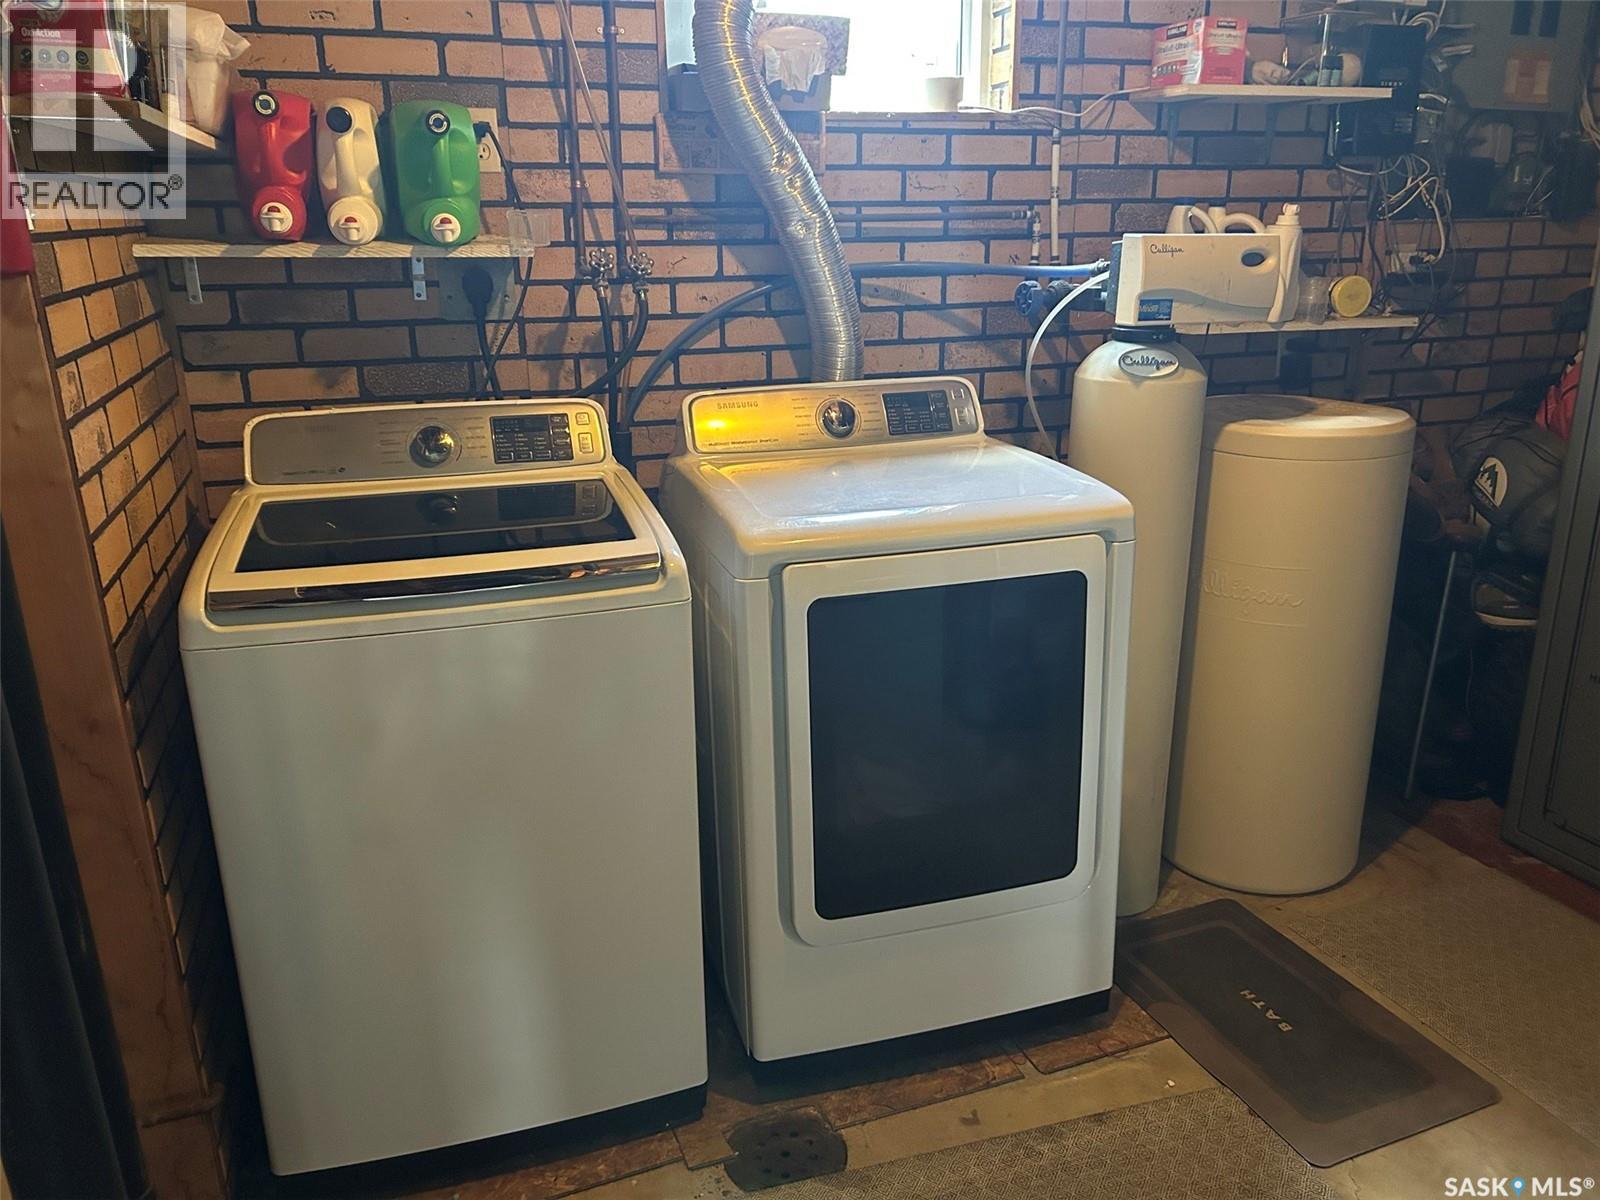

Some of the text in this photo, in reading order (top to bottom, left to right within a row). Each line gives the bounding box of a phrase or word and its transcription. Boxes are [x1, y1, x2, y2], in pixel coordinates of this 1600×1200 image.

[1150, 243, 1184, 258] Culligan
[1122, 355, 1178, 370] Culligan
[717, 401, 759, 410] SAMSUNG
[1240, 989, 1294, 1032] BATH
